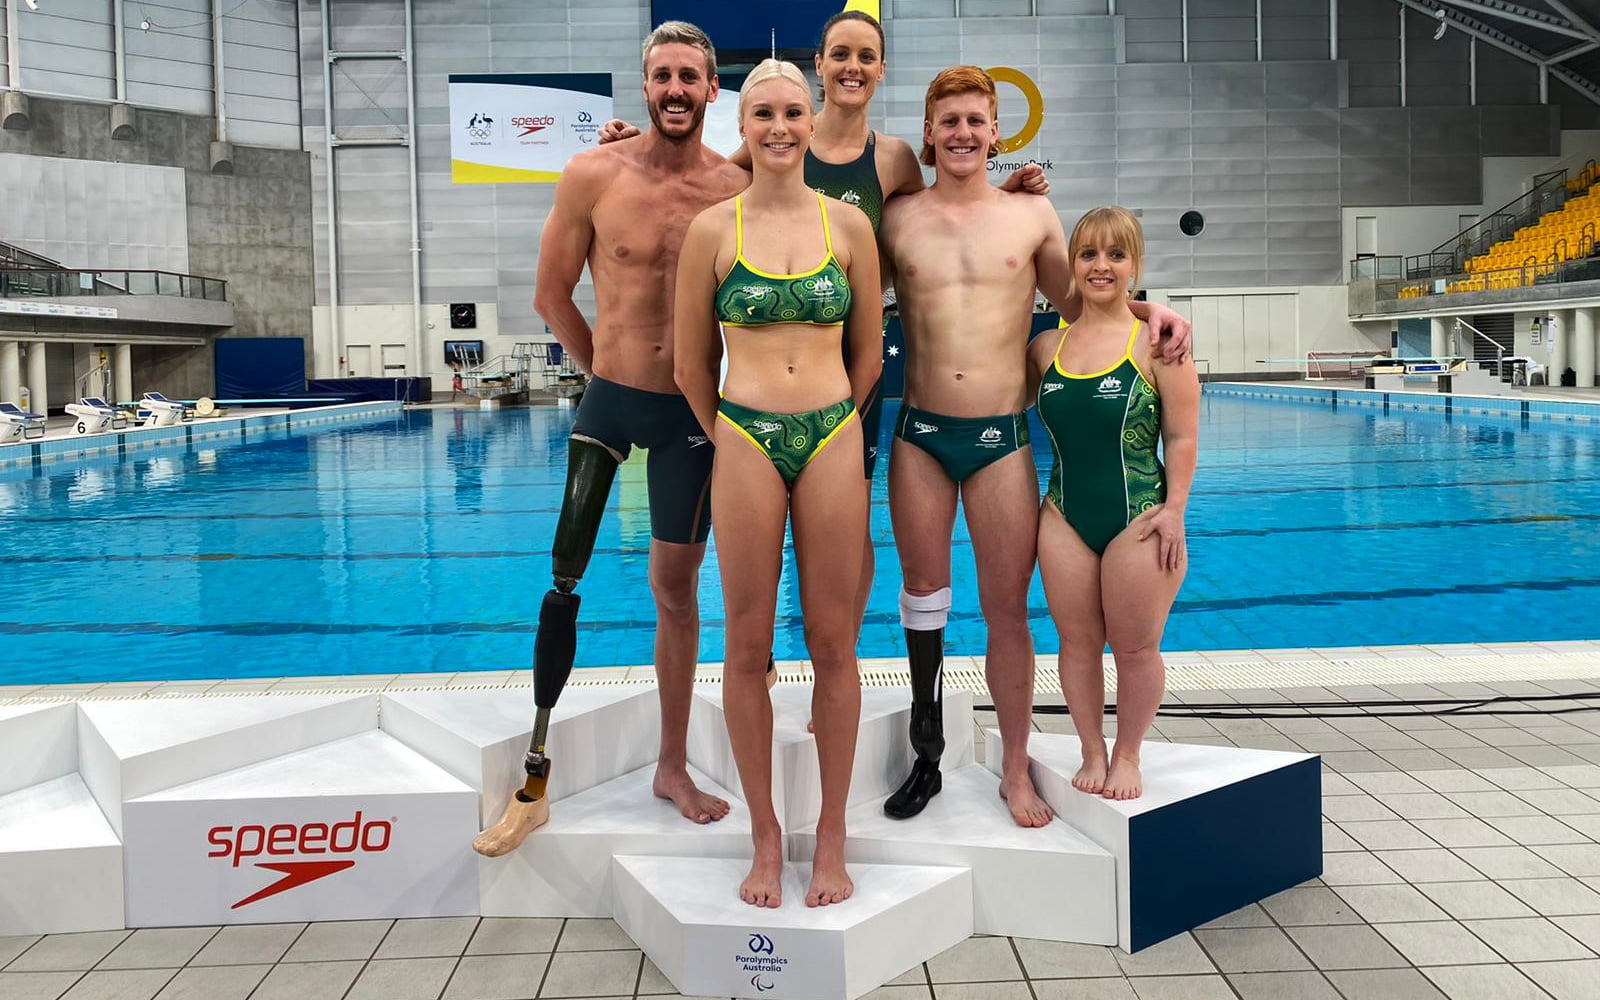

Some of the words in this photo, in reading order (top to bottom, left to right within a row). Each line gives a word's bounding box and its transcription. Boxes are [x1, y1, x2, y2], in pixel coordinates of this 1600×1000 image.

[511, 115, 555, 128] speedo
[986, 159, 1053, 174] OlympicPrk
[151, 414, 159, 425] 7
[77, 421, 86, 434] 6
[752, 420, 782, 431] speedo
[914, 421, 939, 432] speedo
[207, 810, 392, 868] speedo
[735, 955, 788, 965] Paralympics
[742, 964, 782, 972] Australia
